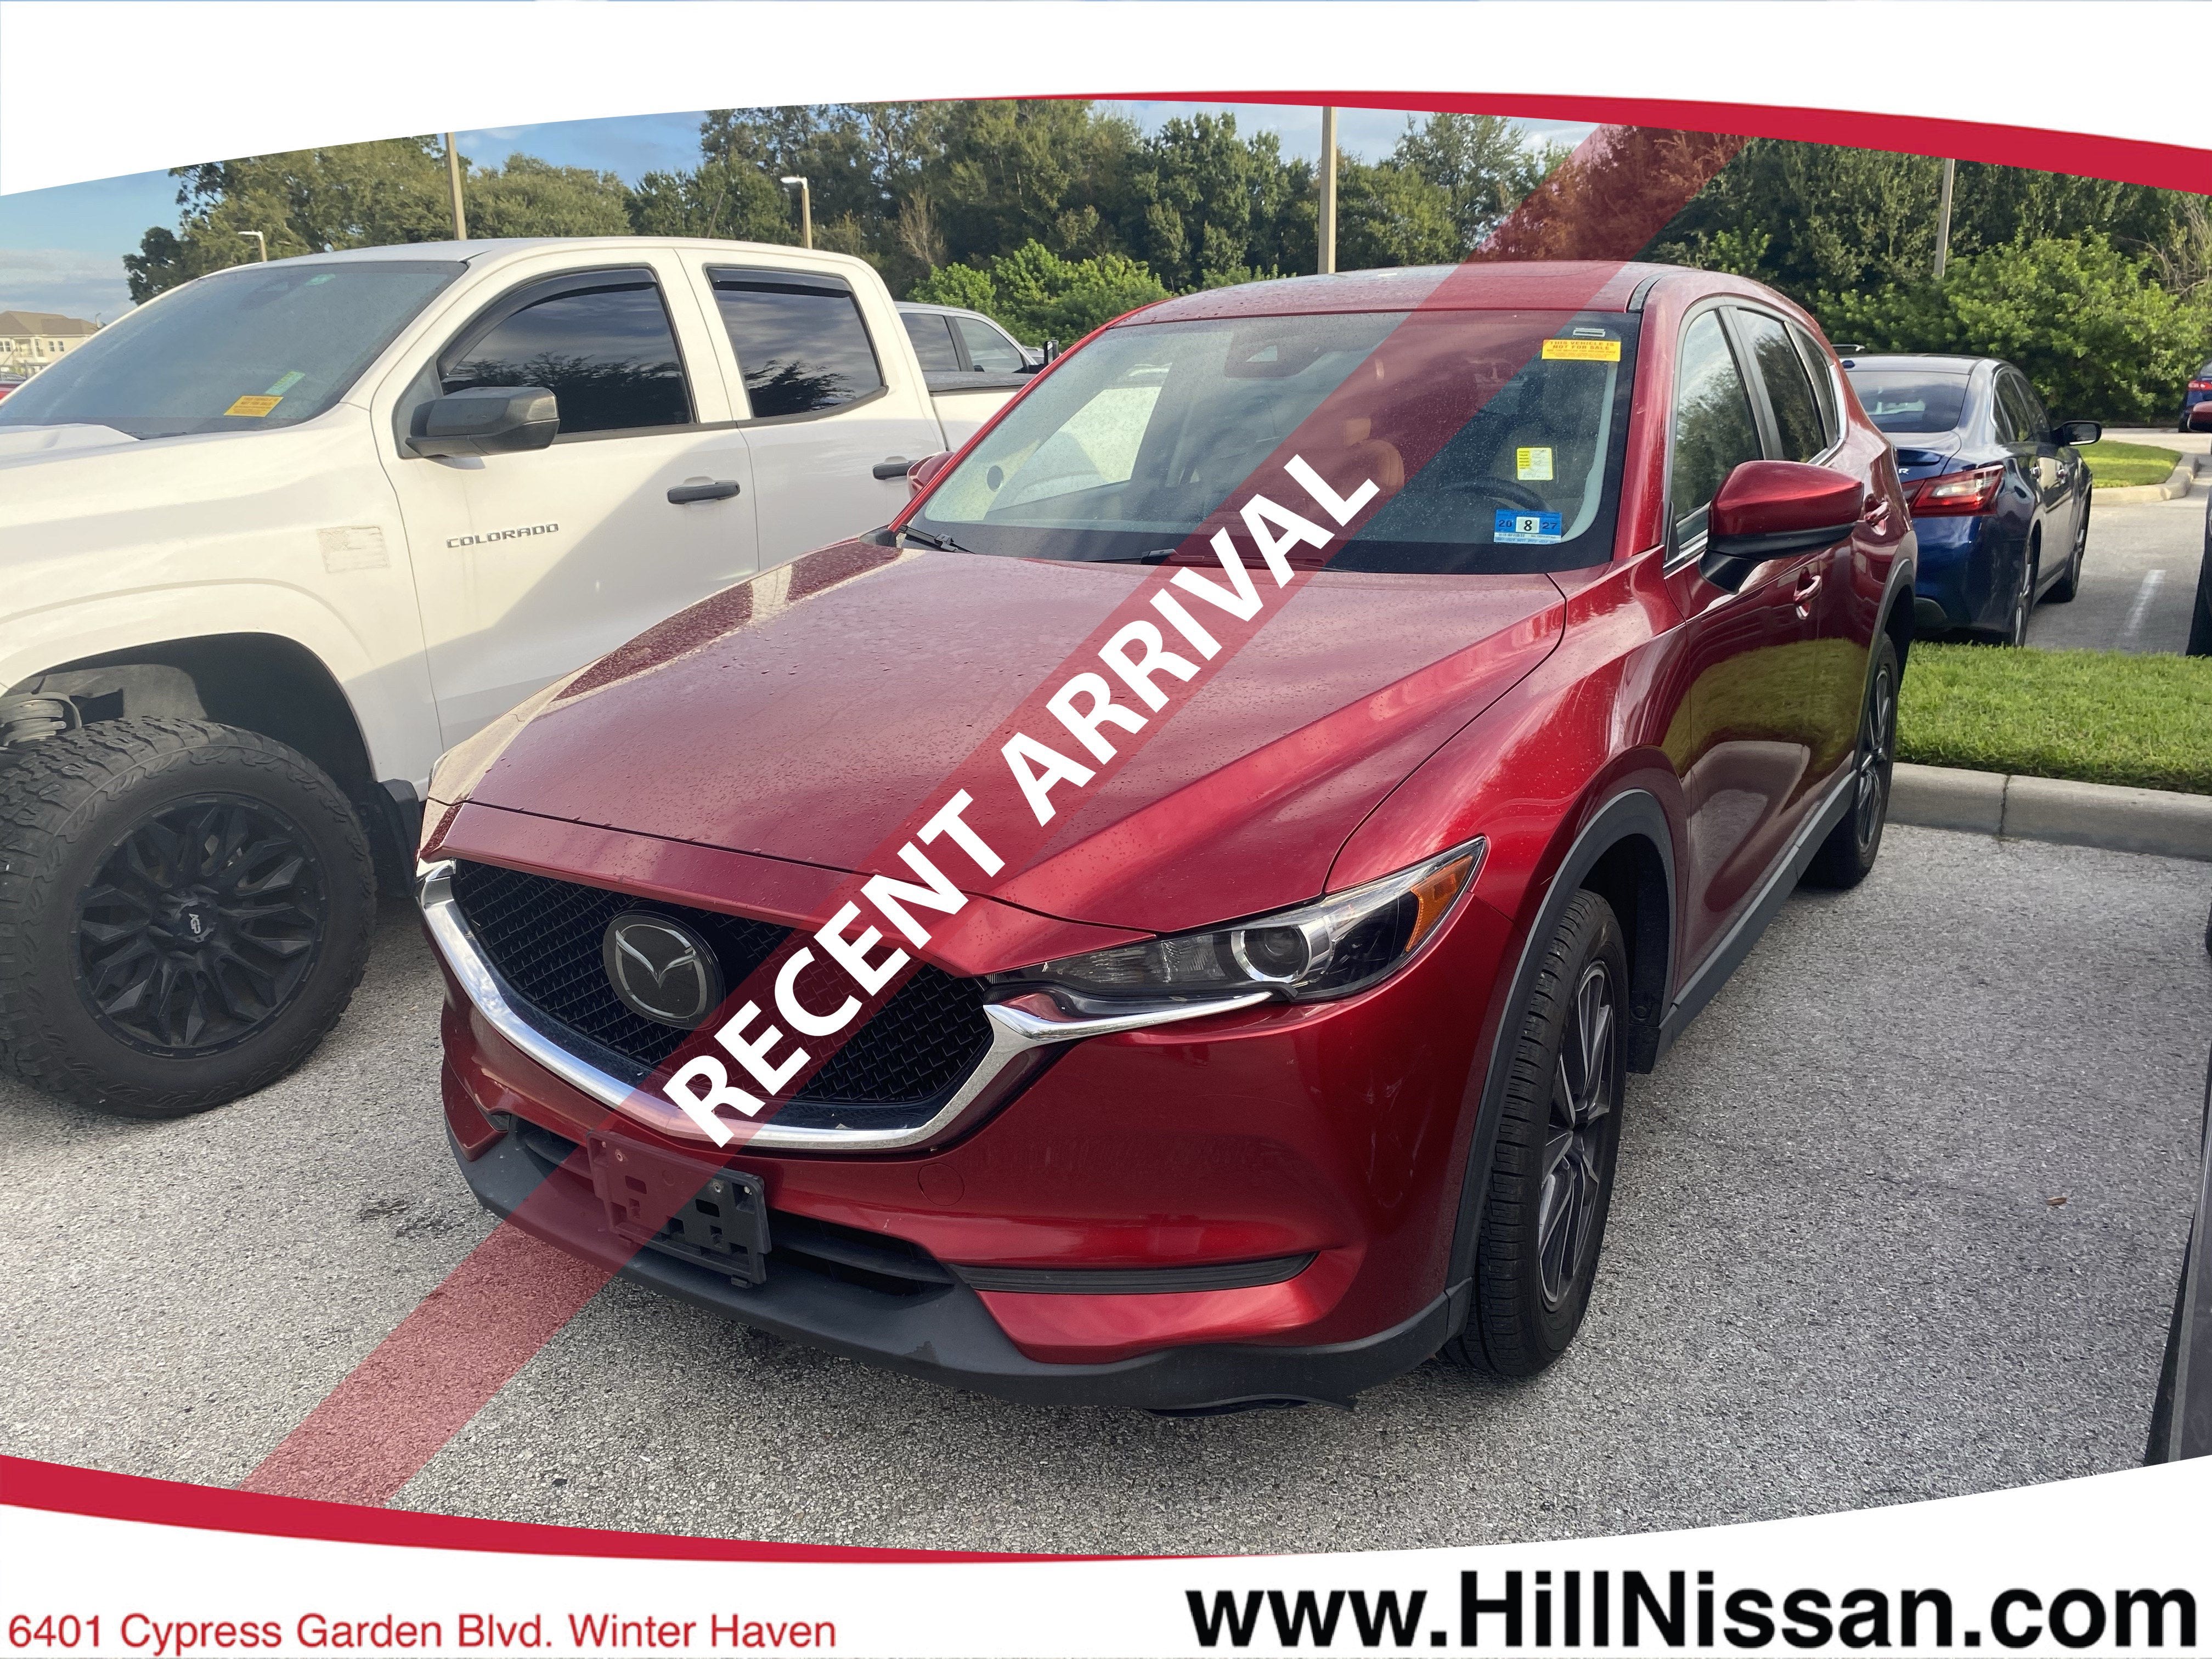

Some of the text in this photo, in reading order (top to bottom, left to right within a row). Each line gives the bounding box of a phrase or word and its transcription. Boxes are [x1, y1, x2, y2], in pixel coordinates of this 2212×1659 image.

[1498, 519, 1558, 532] 20 8 27
[446, 523, 559, 549] COLORADO
